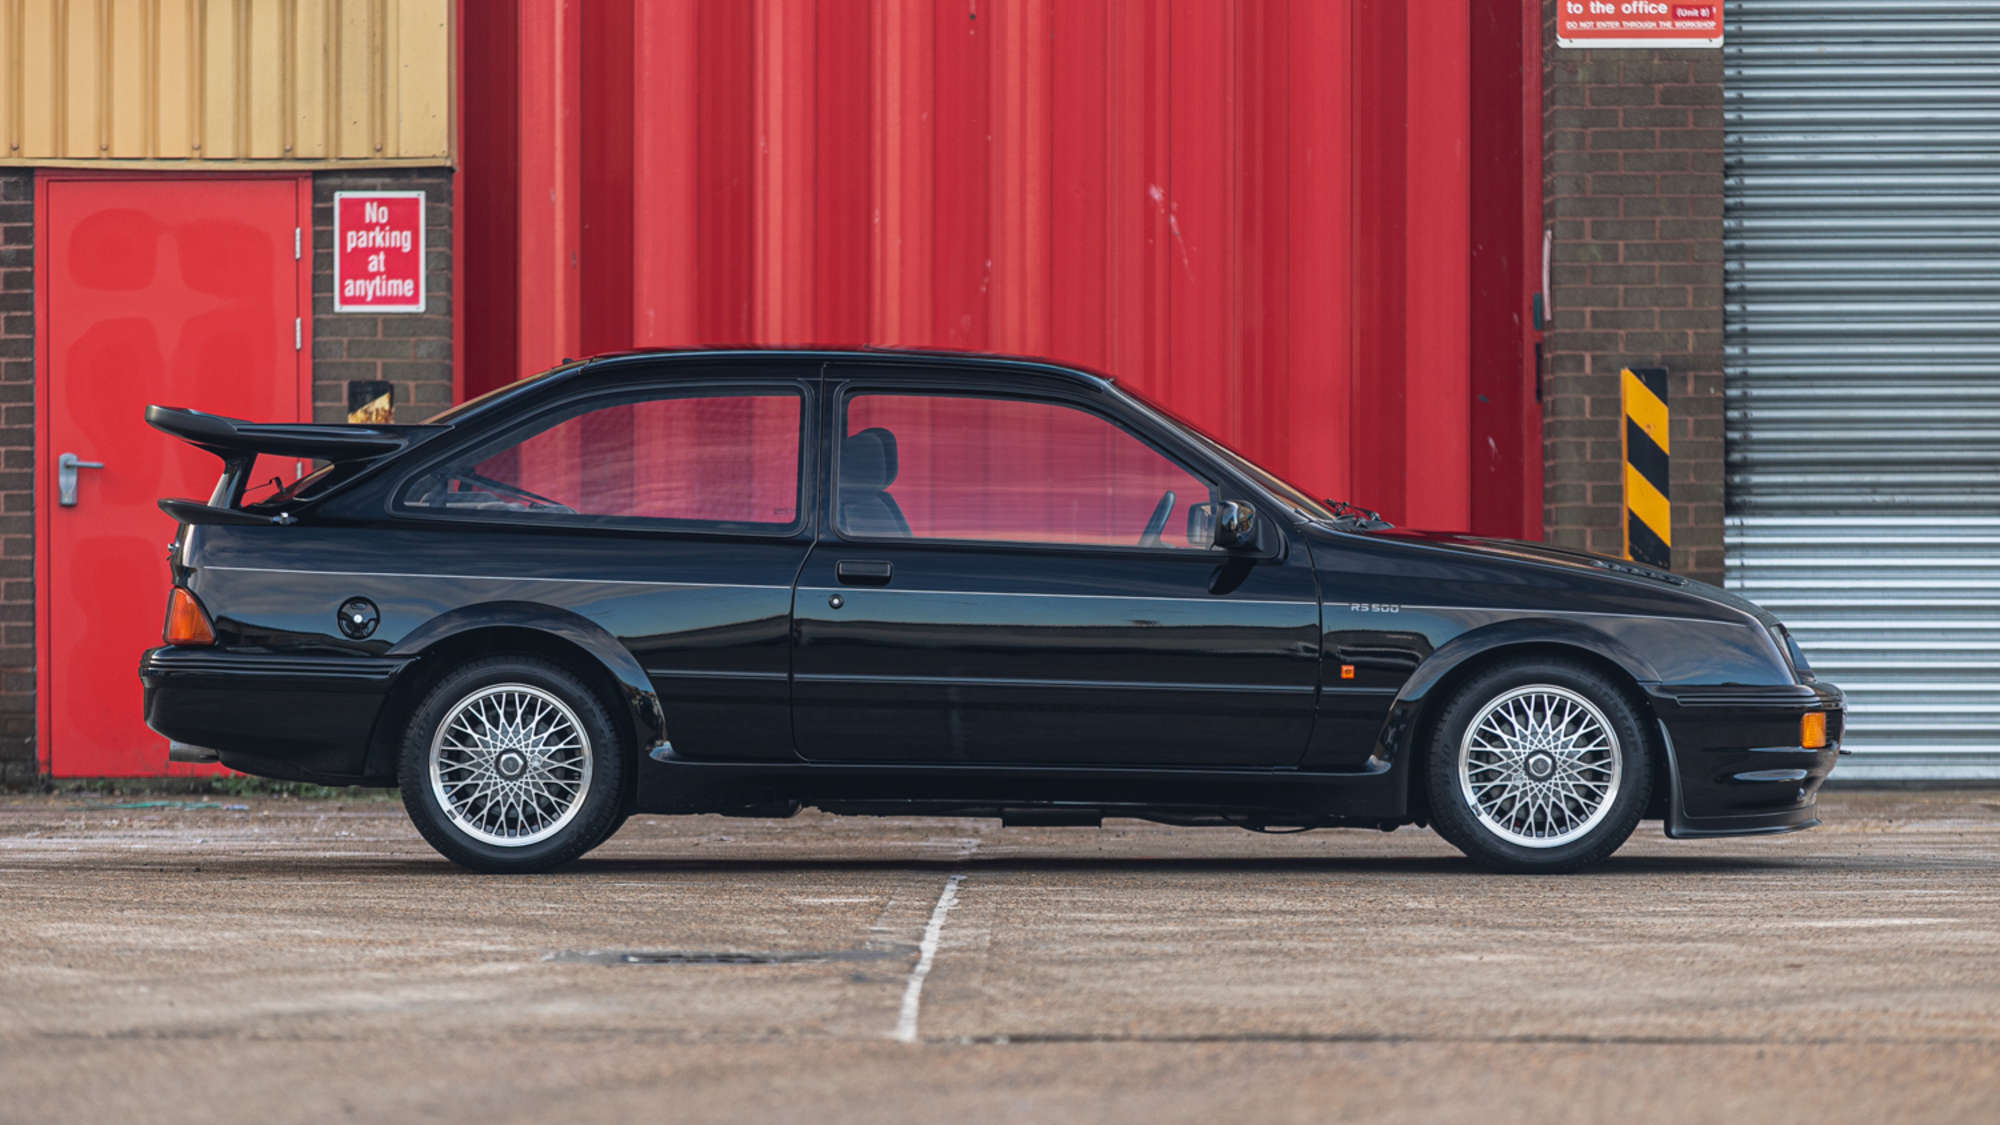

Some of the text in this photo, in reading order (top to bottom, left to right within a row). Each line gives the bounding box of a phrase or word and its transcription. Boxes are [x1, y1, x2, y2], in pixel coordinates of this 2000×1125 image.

[1566, 1, 1583, 14] to
[1590, 0, 1615, 14] the
[1621, 0, 1668, 14] office
[1566, 21, 1717, 30] DO NOT ENTER THROUGH THE WORKSHOP
[365, 202, 389, 224] No
[346, 226, 412, 253] parking
[368, 250, 385, 273] at
[344, 275, 414, 302] anytime
[1351, 603, 1399, 613] RS 500
